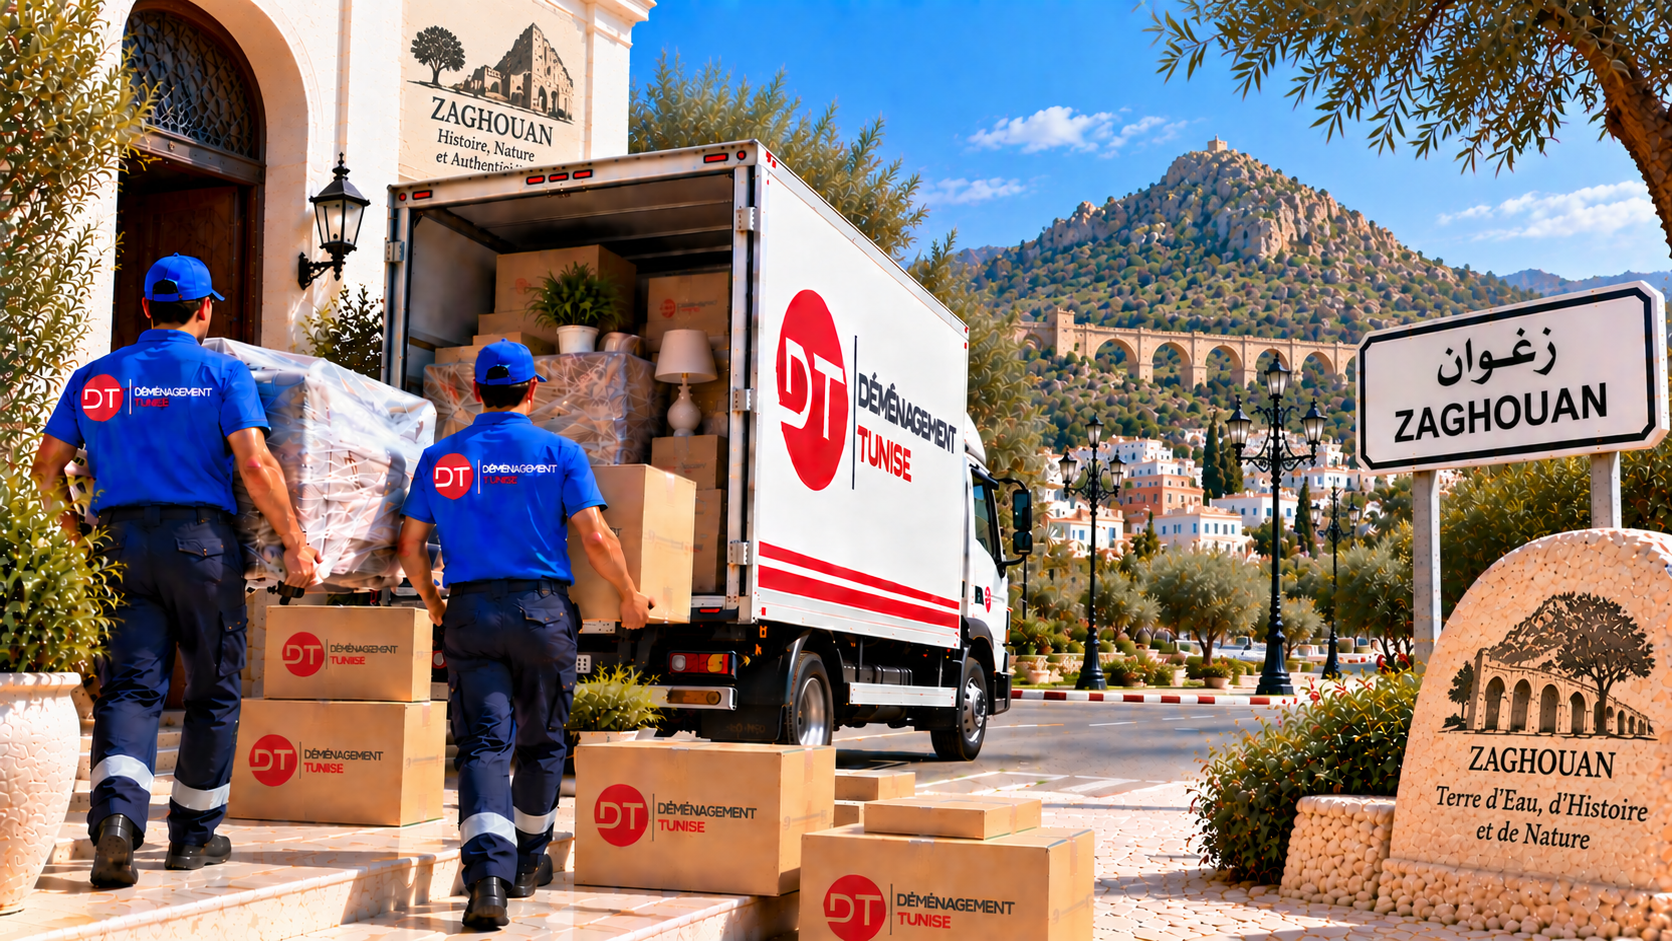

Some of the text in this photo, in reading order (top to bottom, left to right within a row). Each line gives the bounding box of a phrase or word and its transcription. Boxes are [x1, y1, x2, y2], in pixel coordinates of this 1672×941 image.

[430, 96, 553, 147] ZAGHOUAN
[435, 151, 448, 164] et
[437, 128, 535, 162] Histoire, Nature
[1437, 327, 1557, 387] زغوان
[83, 388, 120, 409] DT
[779, 336, 846, 441] DT
[1394, 382, 1608, 443] ZAGHOUAN
[857, 424, 912, 483] TUNISE
[435, 466, 470, 488] DT
[282, 645, 321, 665] DT
[250, 749, 293, 771] DT
[1468, 746, 1616, 779] ZAGHOUAN
[595, 796, 644, 830] DT
[1436, 785, 1649, 822] Terre d'Eau, d'Histoire
[657, 819, 706, 833] TUNISE
[1476, 820, 1591, 849] et de Nature
[826, 893, 882, 926] DT
[897, 911, 952, 929] TUNISE
